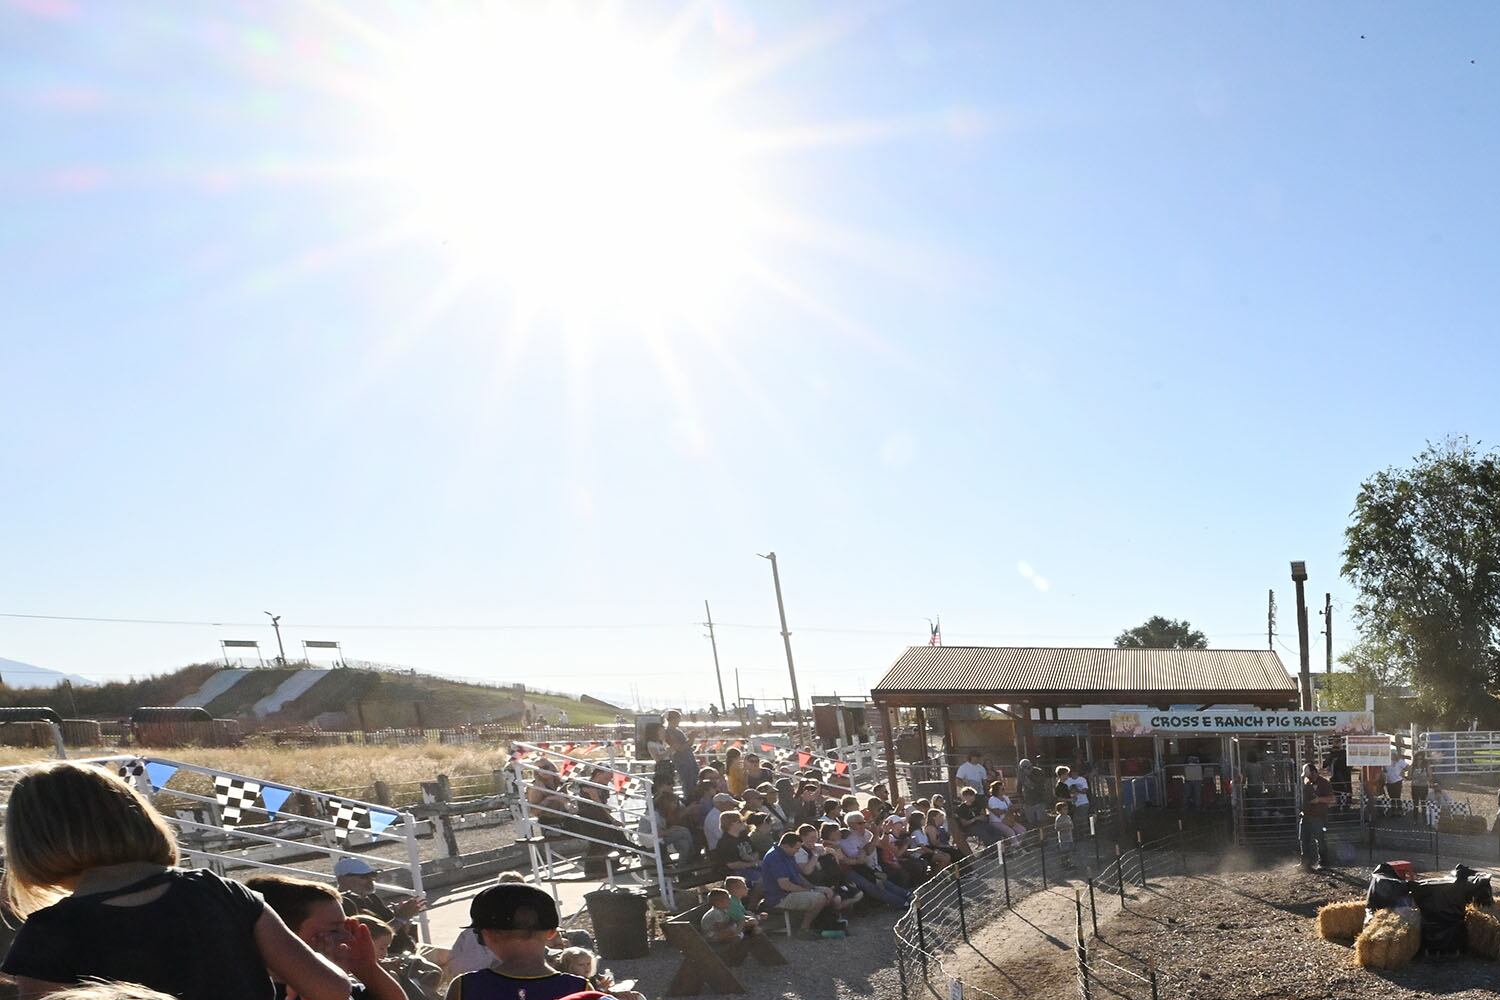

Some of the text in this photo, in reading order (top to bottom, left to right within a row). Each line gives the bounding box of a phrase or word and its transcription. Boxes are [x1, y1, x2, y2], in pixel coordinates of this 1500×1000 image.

[1150, 716, 1337, 728] CROSS E RANCH PIG RACES
